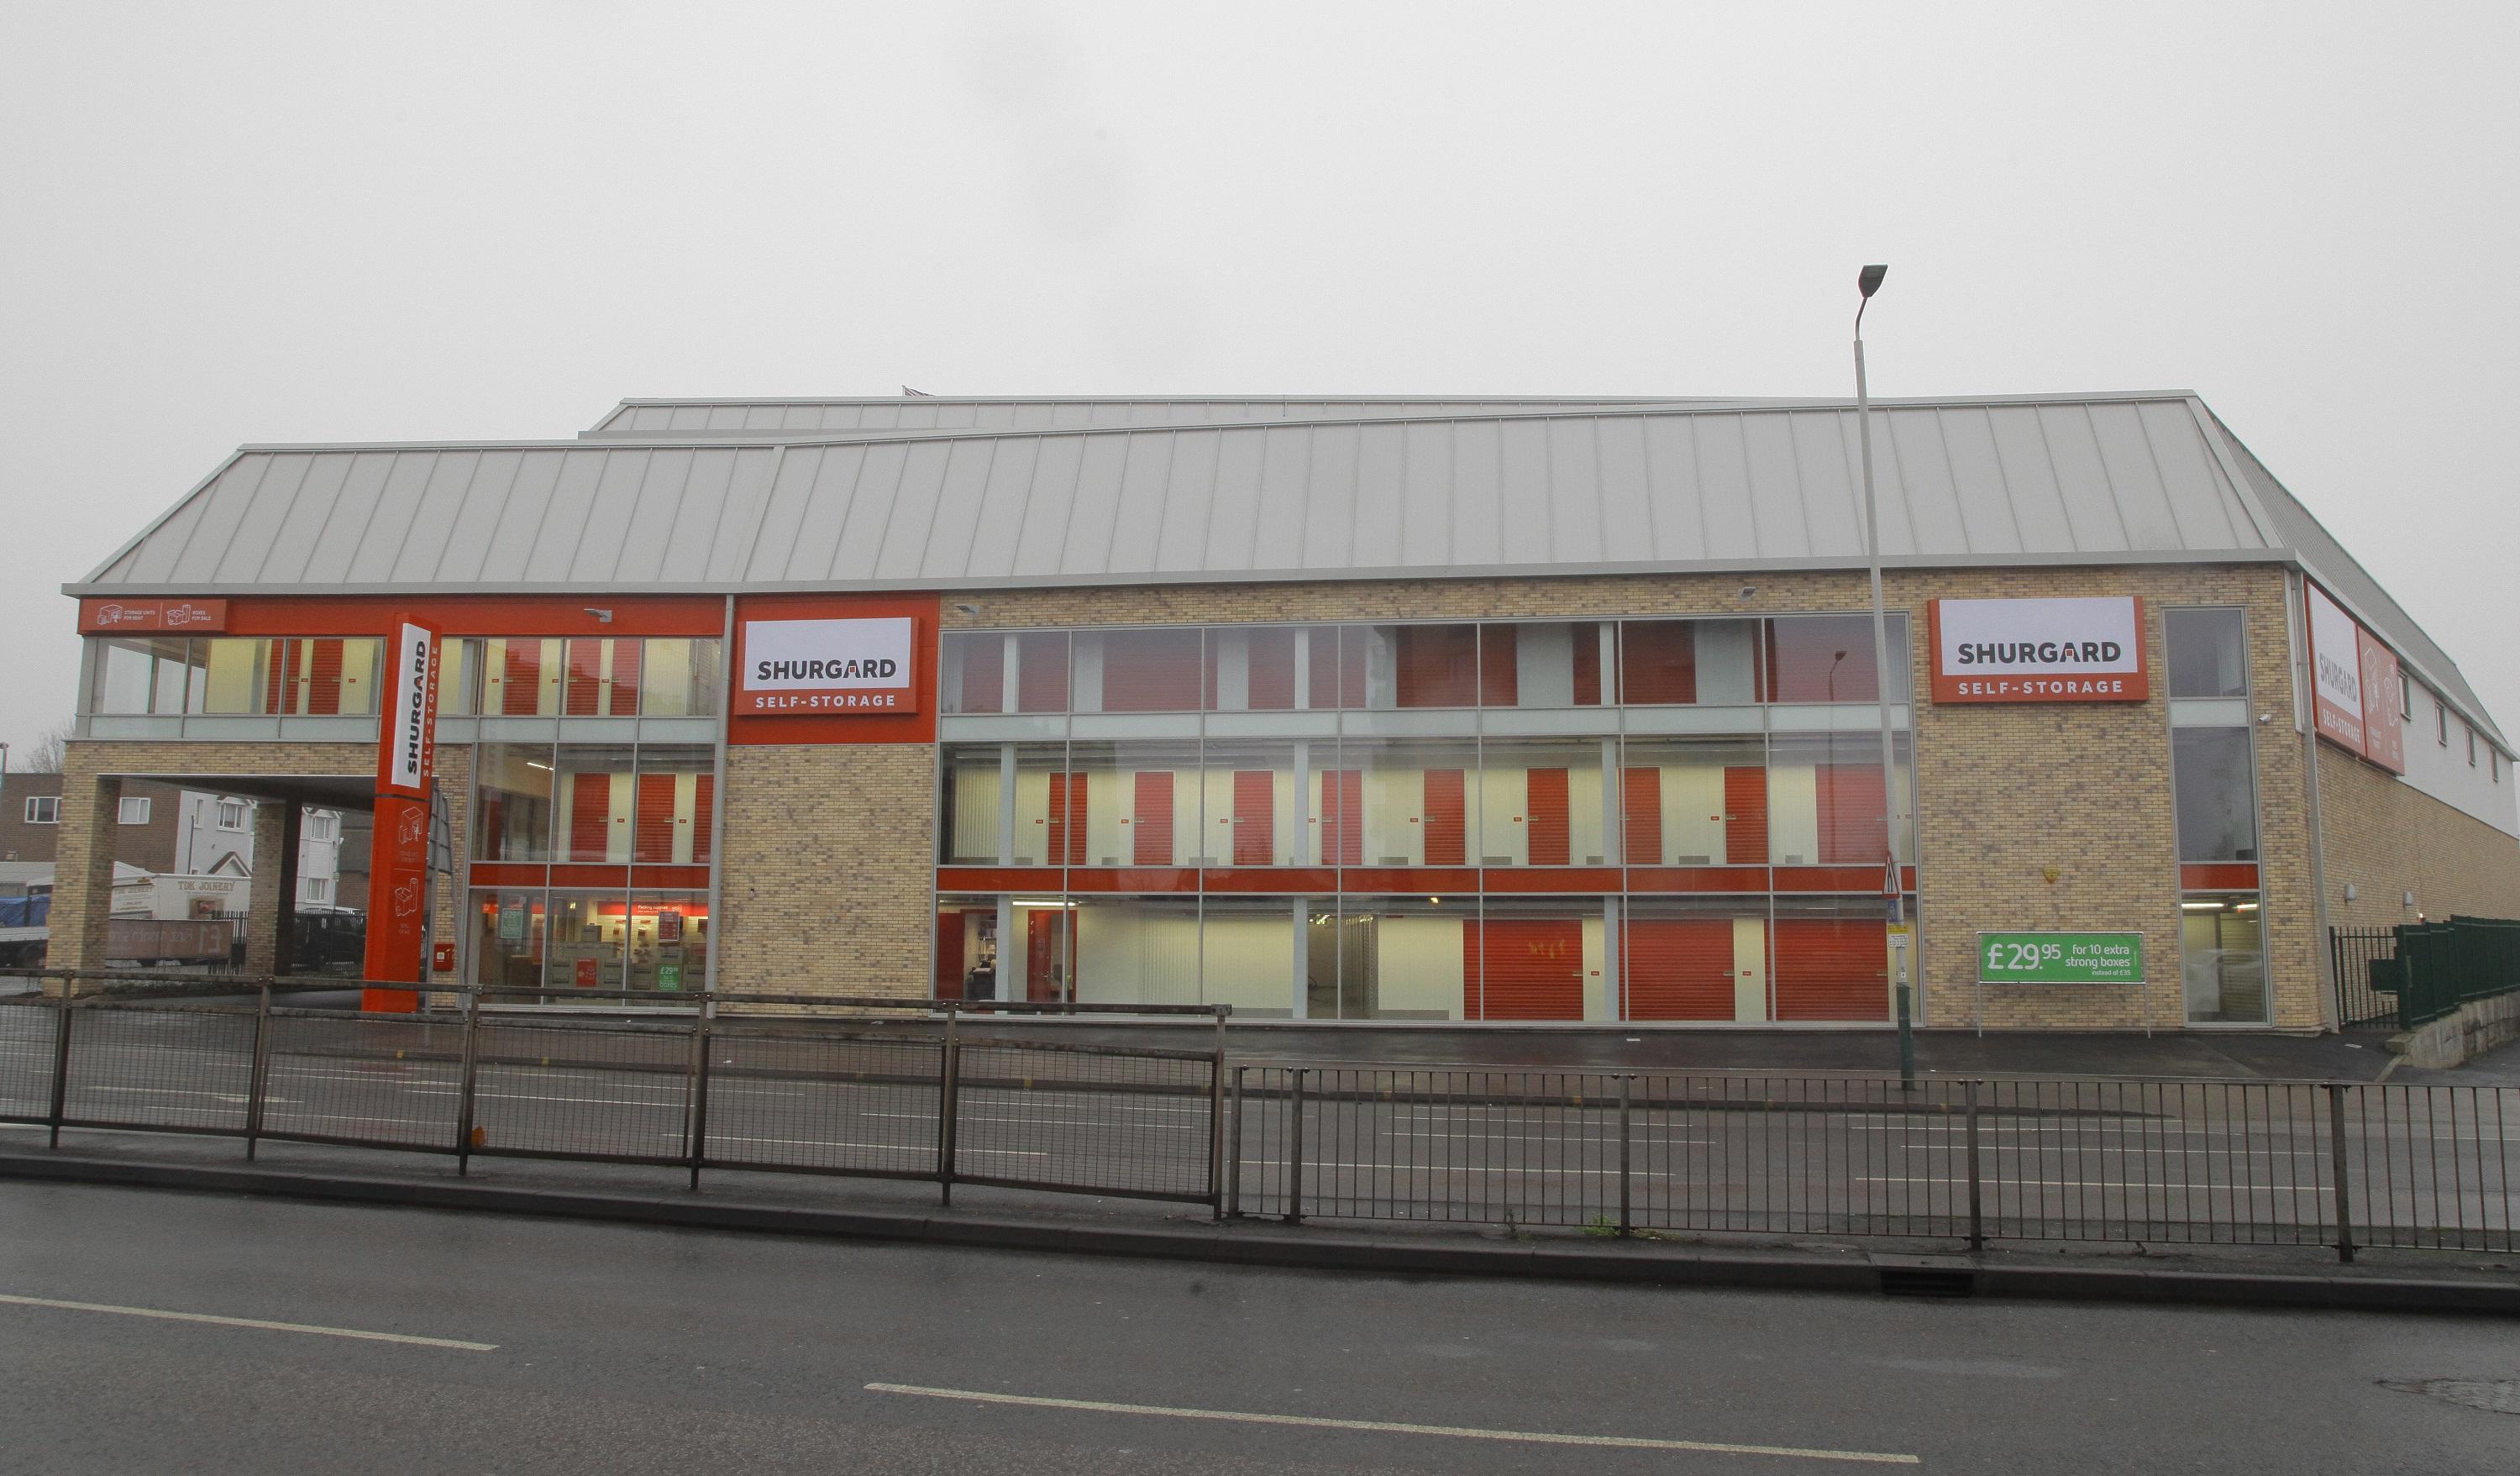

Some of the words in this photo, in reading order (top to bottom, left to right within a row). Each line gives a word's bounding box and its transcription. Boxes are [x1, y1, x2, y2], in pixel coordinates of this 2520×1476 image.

[1957, 641, 2122, 664] SHURGARD
[757, 659, 896, 680] SHURGARD
[2318, 652, 2358, 703] SHURGARD
[1958, 680, 2123, 696] SELF-STORAGE
[408, 640, 426, 775] SHURGARD
[423, 646, 438, 777] SELF-STORAGE
[755, 695, 895, 708] SELF-STORAGE
[2323, 708, 2361, 744] SELF-STORAGE
[199, 880, 236, 891] JOINERY
[1987, 943, 2061, 969] £29.95
[2072, 944, 2087, 954] for
[2089, 944, 2101, 954] 10
[2103, 944, 2129, 954] extra
[2066, 956, 2098, 969] strong
